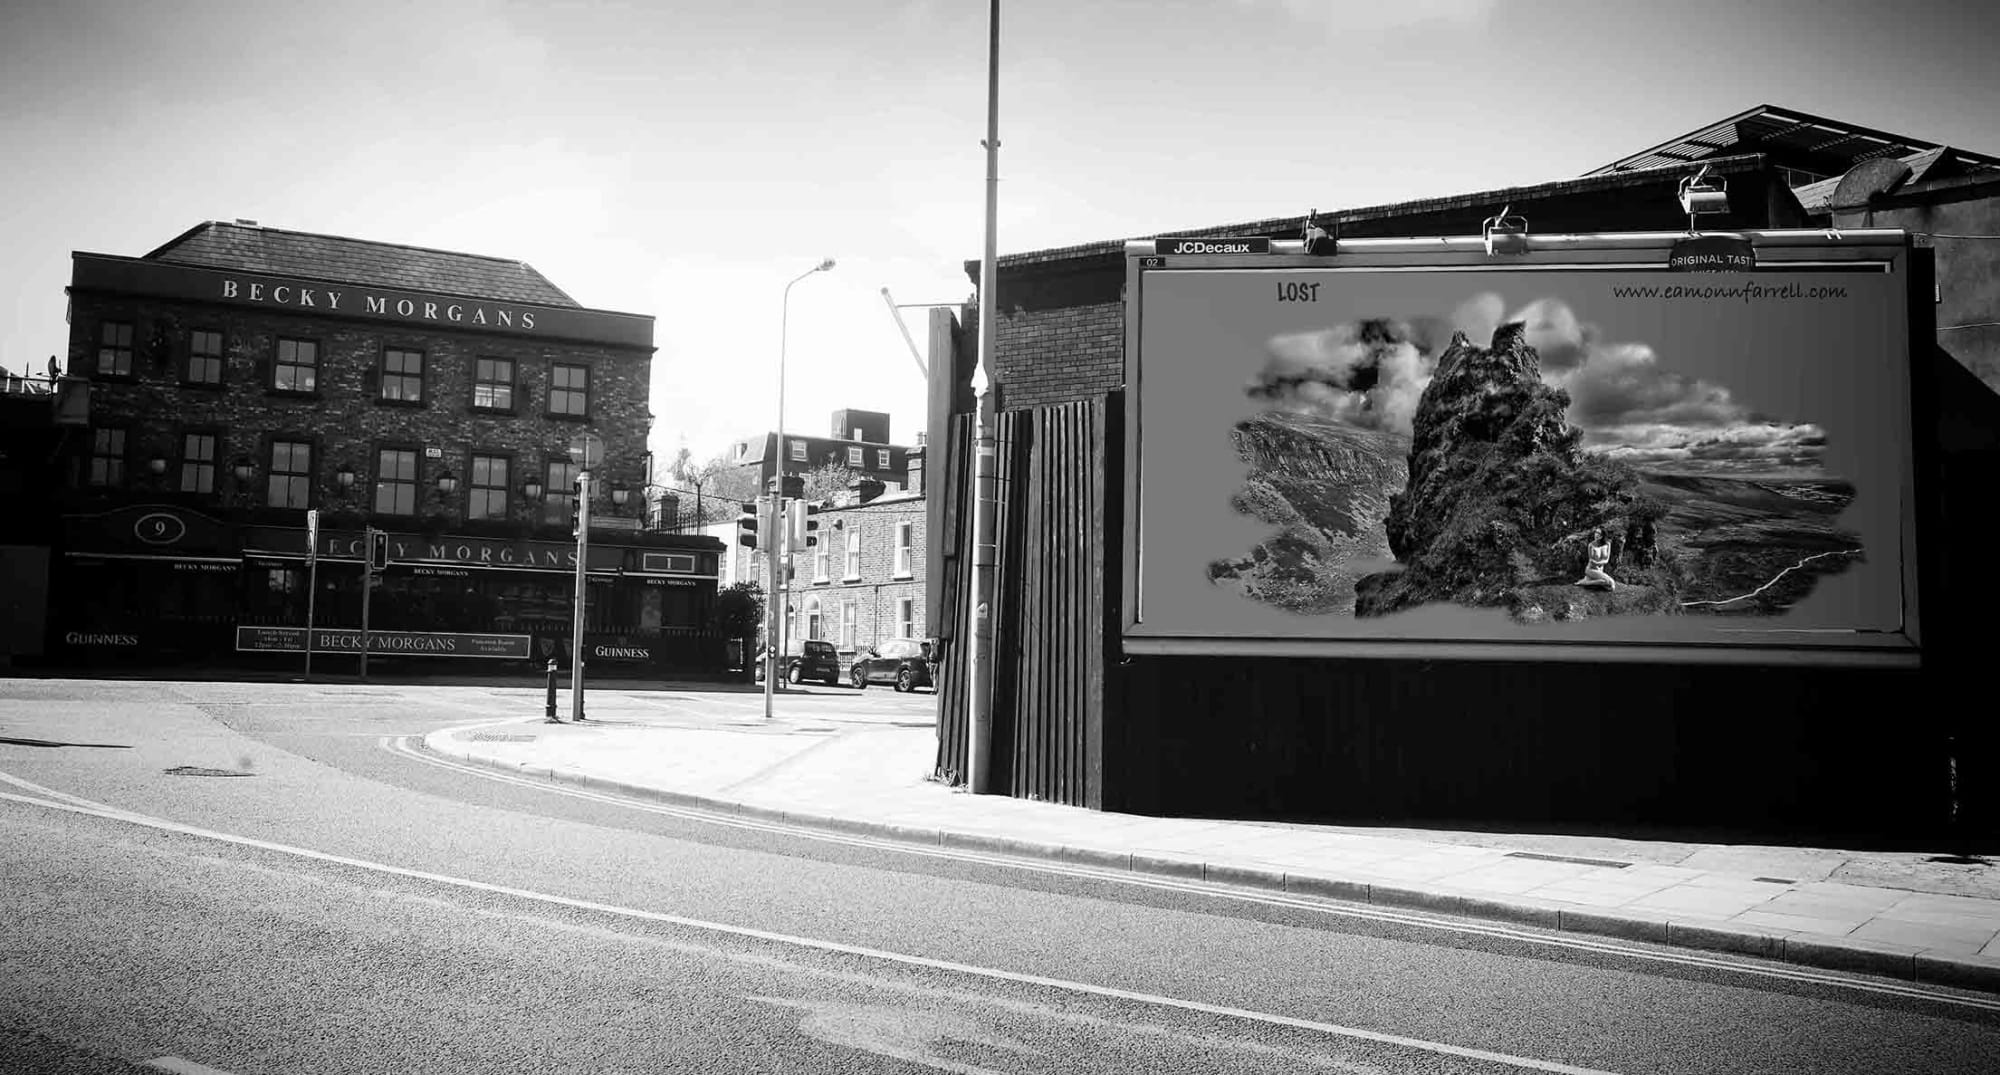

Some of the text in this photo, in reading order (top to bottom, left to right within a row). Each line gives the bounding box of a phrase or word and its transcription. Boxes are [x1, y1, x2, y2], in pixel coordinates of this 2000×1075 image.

[1173, 241, 1250, 255] JCDecaux
[1146, 258, 1158, 267] 02
[1671, 254, 1724, 268] ORIGINAL
[1277, 281, 1320, 303] LOST
[1612, 281, 1849, 304] www.eamonnfarrell.com
[223, 280, 537, 330] BECKY MORGANS
[428, 543, 578, 567] MORGANS
[64, 631, 139, 647] GUINNESS
[320, 635, 456, 652] BECKY MORGANS
[594, 644, 650, 659] GUINNESS
